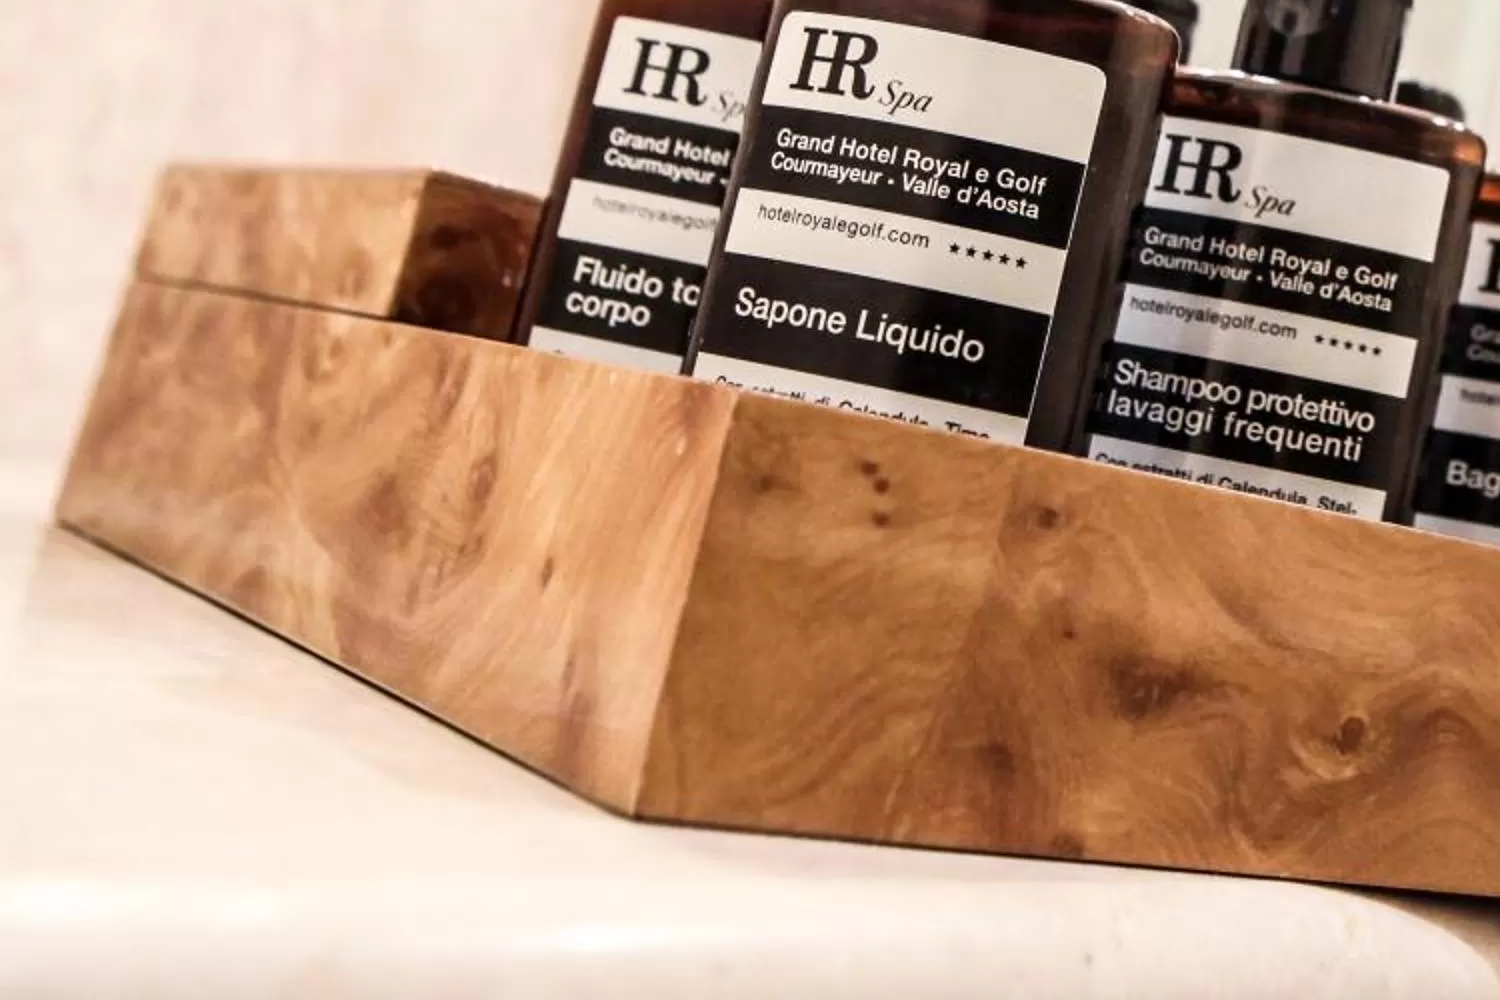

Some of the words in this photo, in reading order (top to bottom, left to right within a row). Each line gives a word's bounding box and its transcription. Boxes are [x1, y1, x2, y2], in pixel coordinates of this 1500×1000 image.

[621, 36, 710, 107] HR
[711, 88, 746, 122] Sp
[789, 26, 879, 101] HR
[876, 79, 934, 115] Spa
[603, 148, 717, 185] Courmayeur
[609, 126, 670, 155] Grand
[674, 138, 731, 166] Hotel
[776, 127, 836, 155] Grand
[840, 137, 898, 166] Hotel
[903, 149, 969, 182] Royal
[975, 167, 989, 183] e
[997, 166, 1047, 197] Golf
[1153, 134, 1243, 204] HR
[1244, 185, 1297, 218] Spa
[592, 194, 718, 232] hotelroyalegolf
[771, 151, 883, 187] Courmayeur
[902, 173, 950, 200] Valle
[957, 185, 1040, 220] d'Aosta
[757, 201, 930, 249] hotelroyalegolf.com
[1144, 225, 1204, 252] Grand
[1210, 233, 1265, 264] Hotel
[1269, 247, 1331, 277] Royal
[1335, 264, 1349, 280] e
[1354, 265, 1399, 292] Golf
[565, 292, 651, 328] corpo
[573, 255, 664, 298] Fluido
[1139, 247, 1251, 283] Courmayeur
[1270, 273, 1314, 296] Valle
[1319, 281, 1393, 312] d'Aosta
[734, 287, 847, 335] Sapone
[855, 309, 985, 363] Liquido
[1130, 296, 1298, 341] hotelroyalegolf.com
[1107, 390, 1214, 437] lavaggi
[1223, 412, 1364, 463] frequenti
[1114, 359, 1242, 406] Shampoo
[1246, 390, 1375, 433] protettivo
